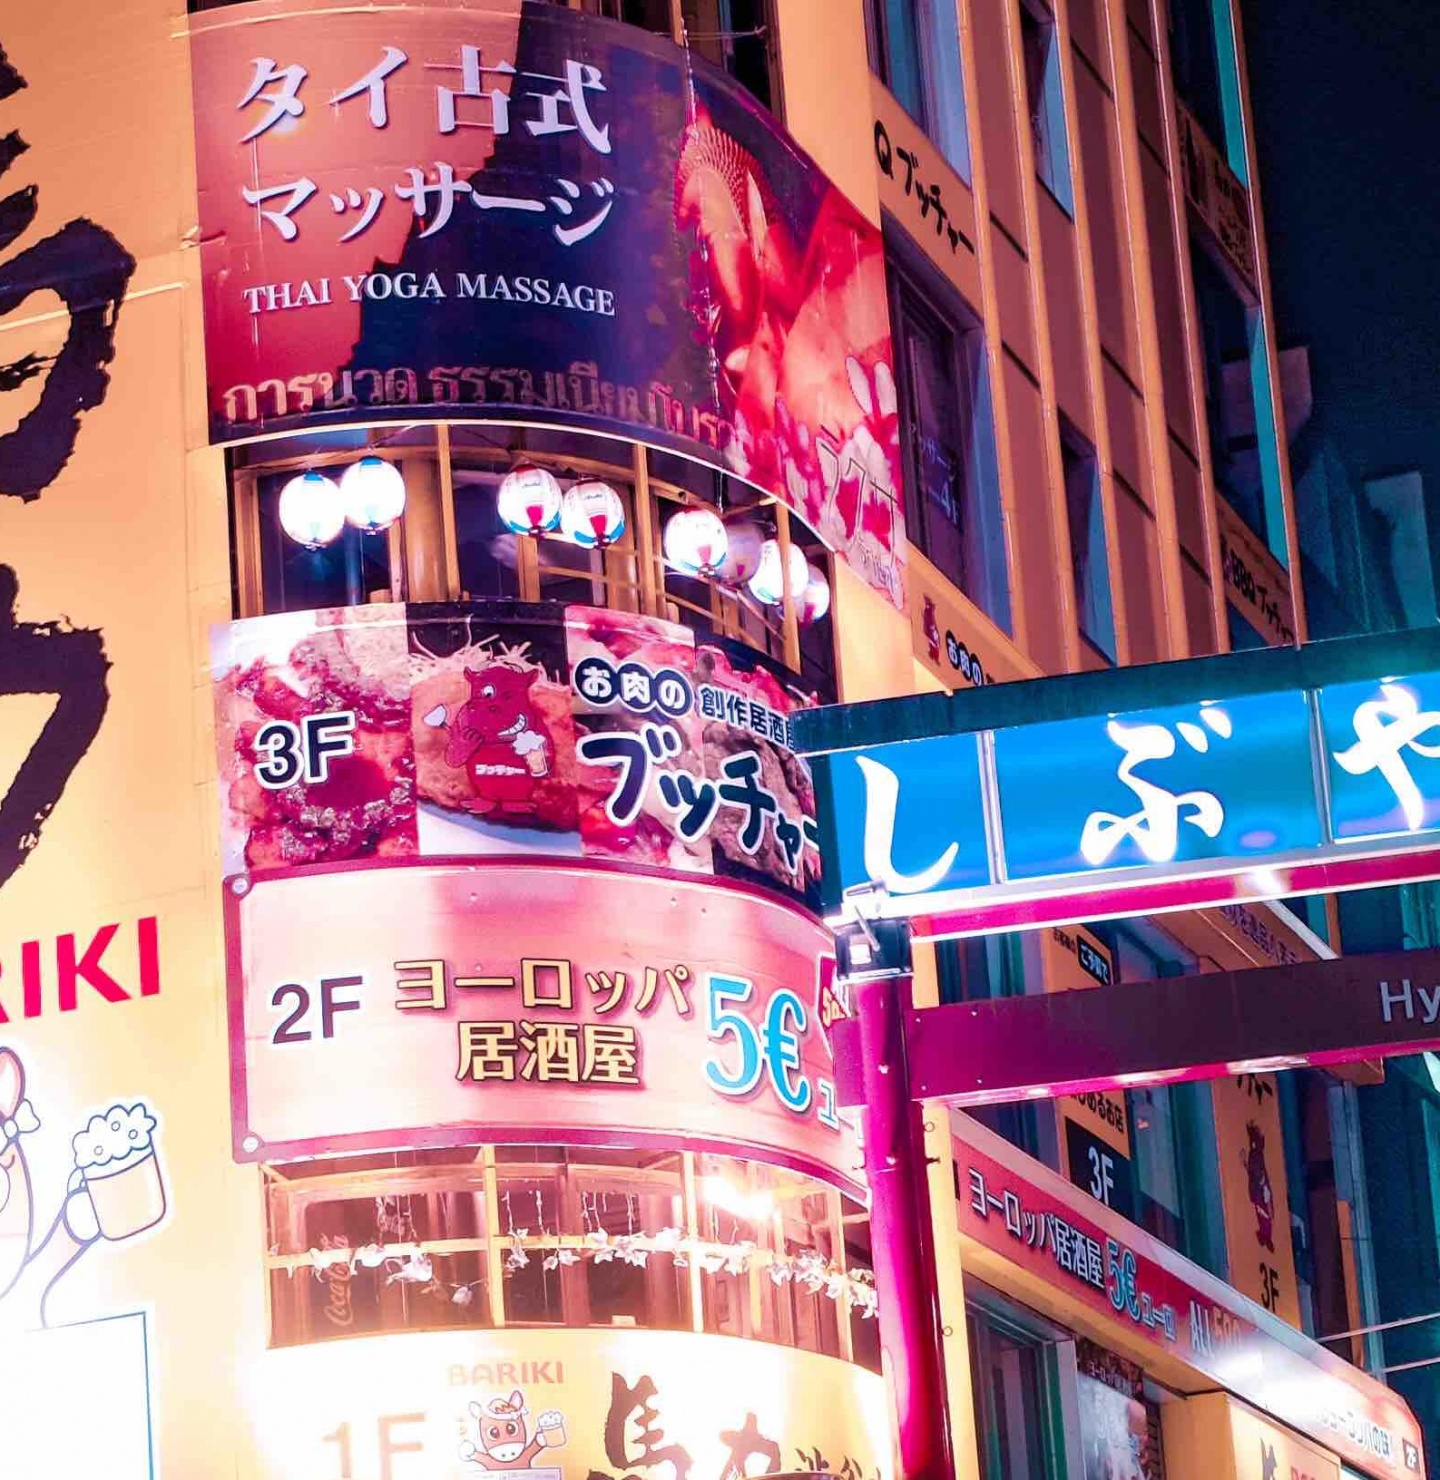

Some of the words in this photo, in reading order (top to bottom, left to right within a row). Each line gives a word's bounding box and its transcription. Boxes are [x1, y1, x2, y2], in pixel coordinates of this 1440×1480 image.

[236, 45, 612, 155] タイ古式
[241, 161, 614, 247] マッサージ
[243, 276, 331, 314] THAI
[342, 272, 446, 302] YOGA
[455, 271, 616, 316] MASSAGE
[579, 662, 689, 713] お肉の
[701, 687, 795, 750] 創作居酒
[256, 712, 354, 789] 3F
[0, 915, 160, 1024] IKI
[394, 957, 691, 1015] ヨーロッパ
[1380, 978, 1440, 1024] Hy
[271, 975, 363, 1044] 2F
[705, 973, 811, 1111] 5€
[456, 1020, 641, 1086] 居酒屋
[1088, 1145, 1114, 1206] 3F
[968, 1167, 1106, 1289] ヨーロッパ居酒屋
[1106, 1236, 1142, 1322] 5€
[1259, 1261, 1280, 1312] 3F
[447, 1359, 565, 1387] BARIKI
